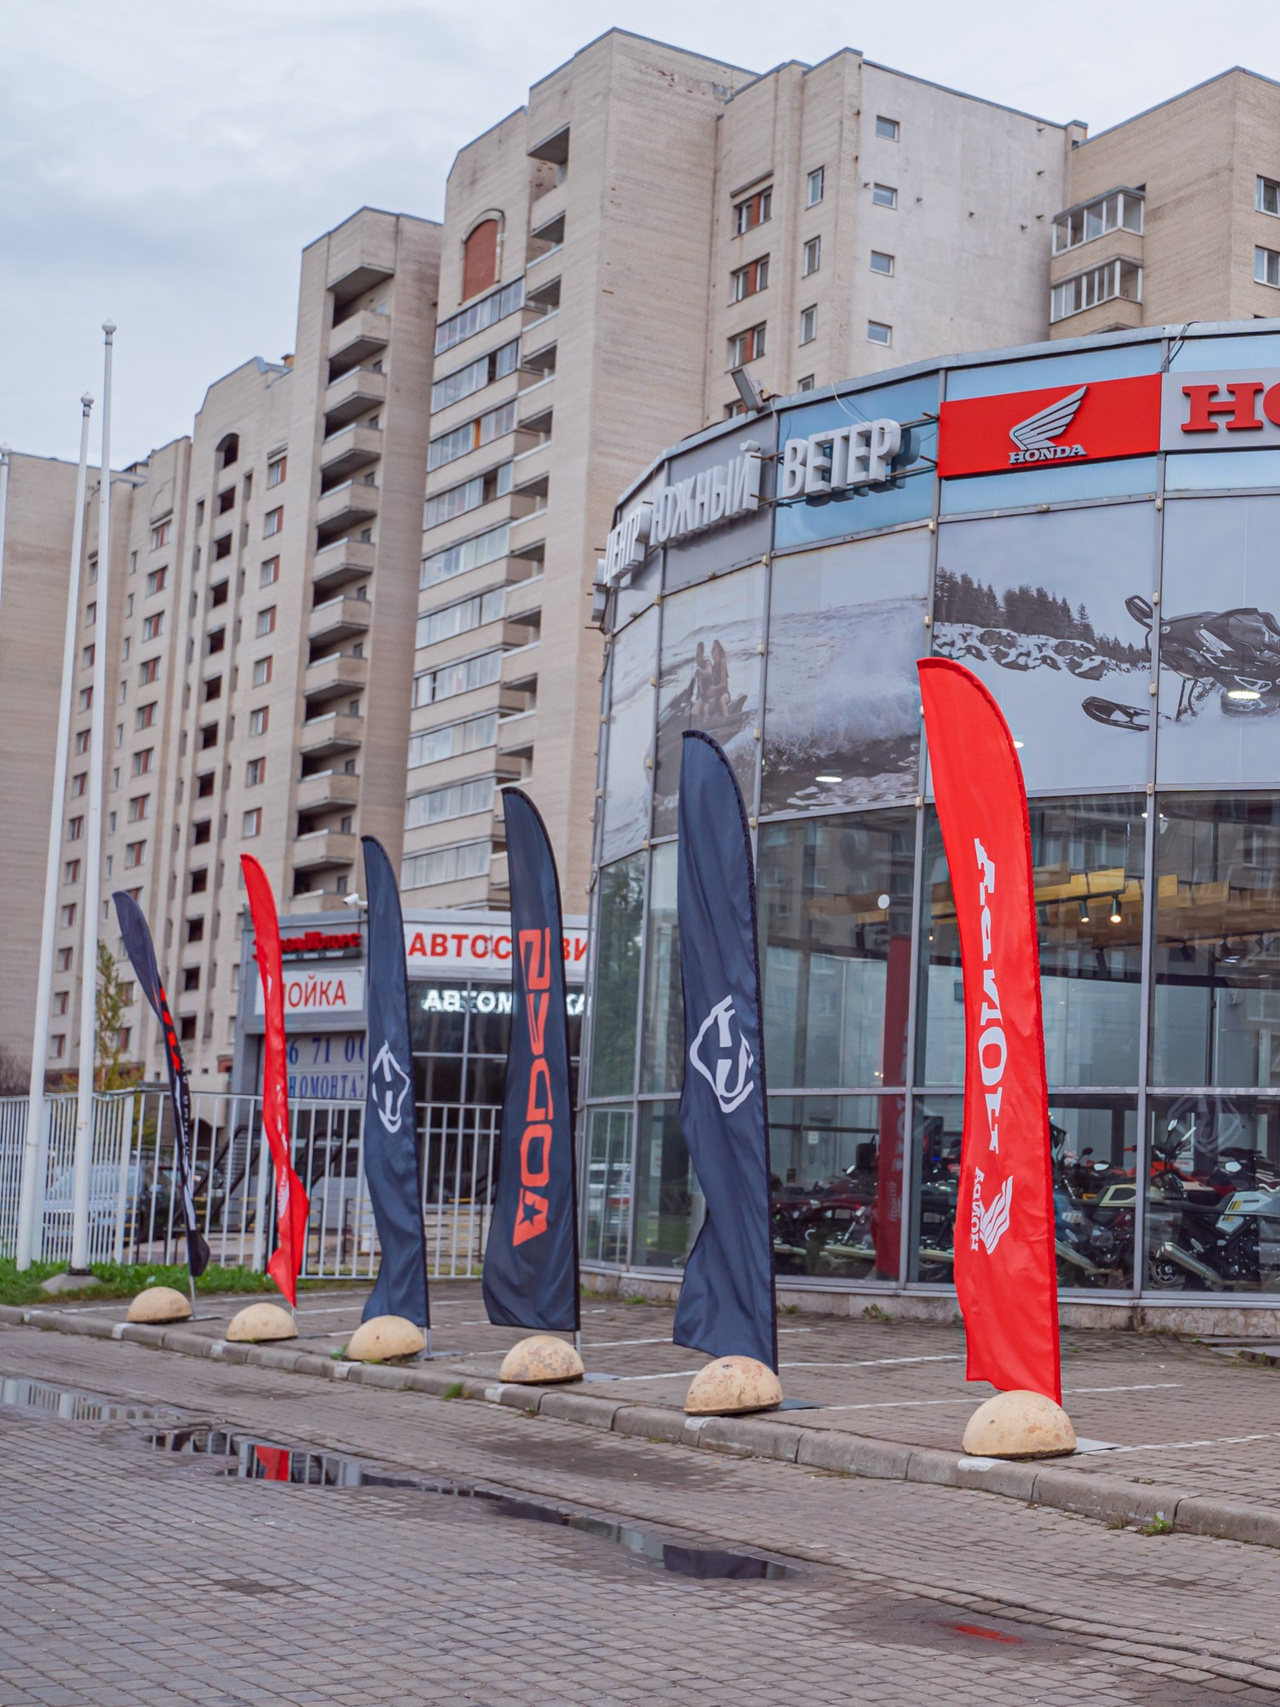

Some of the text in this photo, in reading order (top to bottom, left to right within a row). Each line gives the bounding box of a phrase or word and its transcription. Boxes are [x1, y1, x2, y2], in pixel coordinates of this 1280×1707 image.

[1008, 444, 1087, 465] HONDA
[649, 439, 762, 547] ЮЖНЫЙ
[783, 418, 900, 500] ВЕТЕР
[281, 974, 347, 1009] ОЙКА
[312, 1036, 331, 1064] 71
